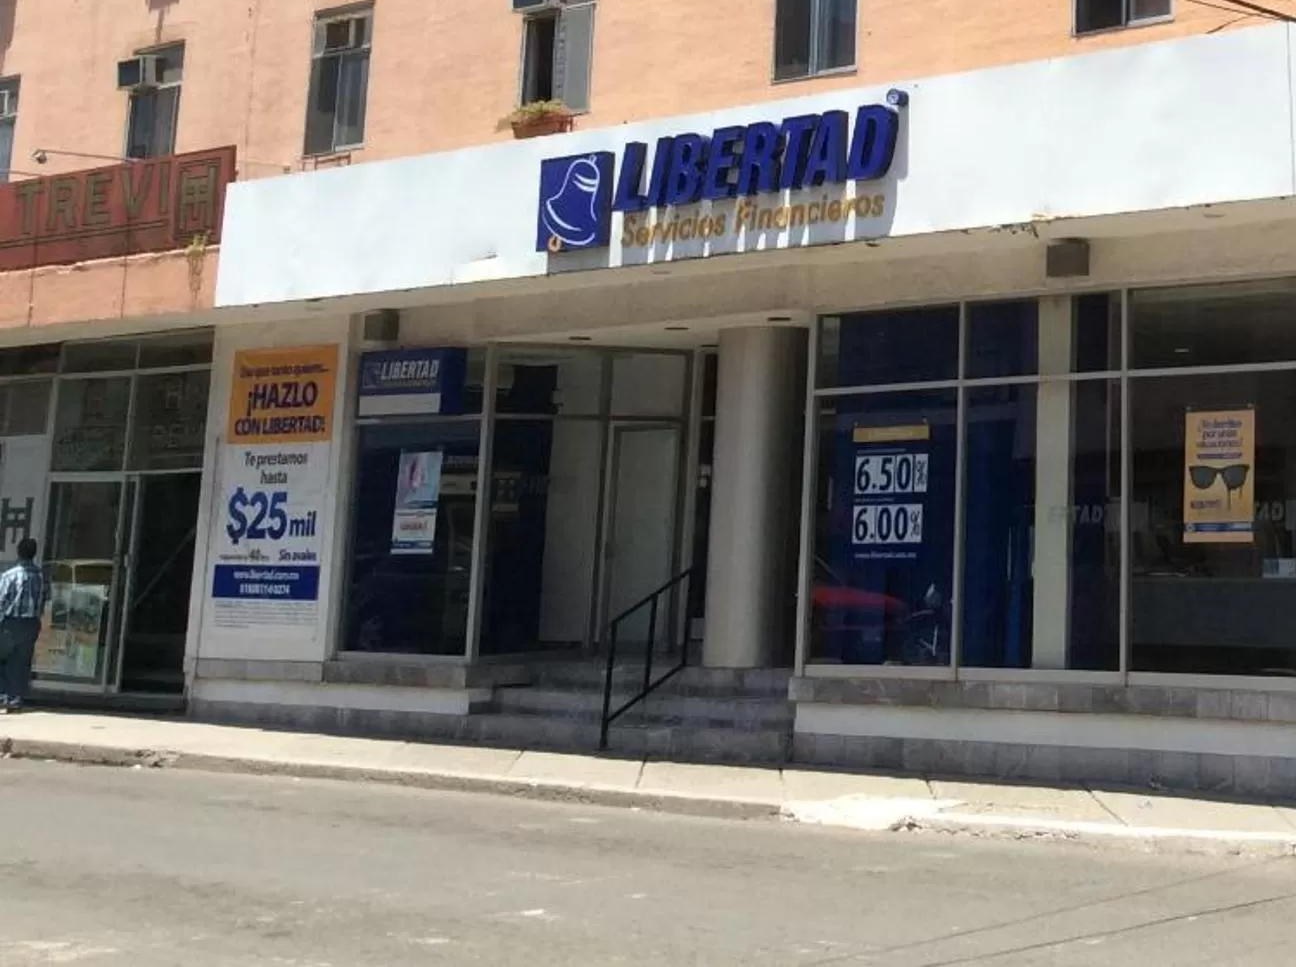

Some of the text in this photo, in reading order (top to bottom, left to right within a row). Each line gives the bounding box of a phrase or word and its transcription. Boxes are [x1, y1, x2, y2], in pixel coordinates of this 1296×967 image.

[612, 104, 899, 212] LIBERTAD
[17, 163, 172, 235] TREVI
[621, 192, 886, 247] Servicios Financieros
[381, 360, 440, 380] LIBERTAD
[247, 381, 318, 416] ¡HAZLO
[234, 418, 261, 436] CON
[244, 450, 309, 469] Te prestamos
[260, 469, 289, 484] hasta
[226, 486, 317, 544] $25 mil
